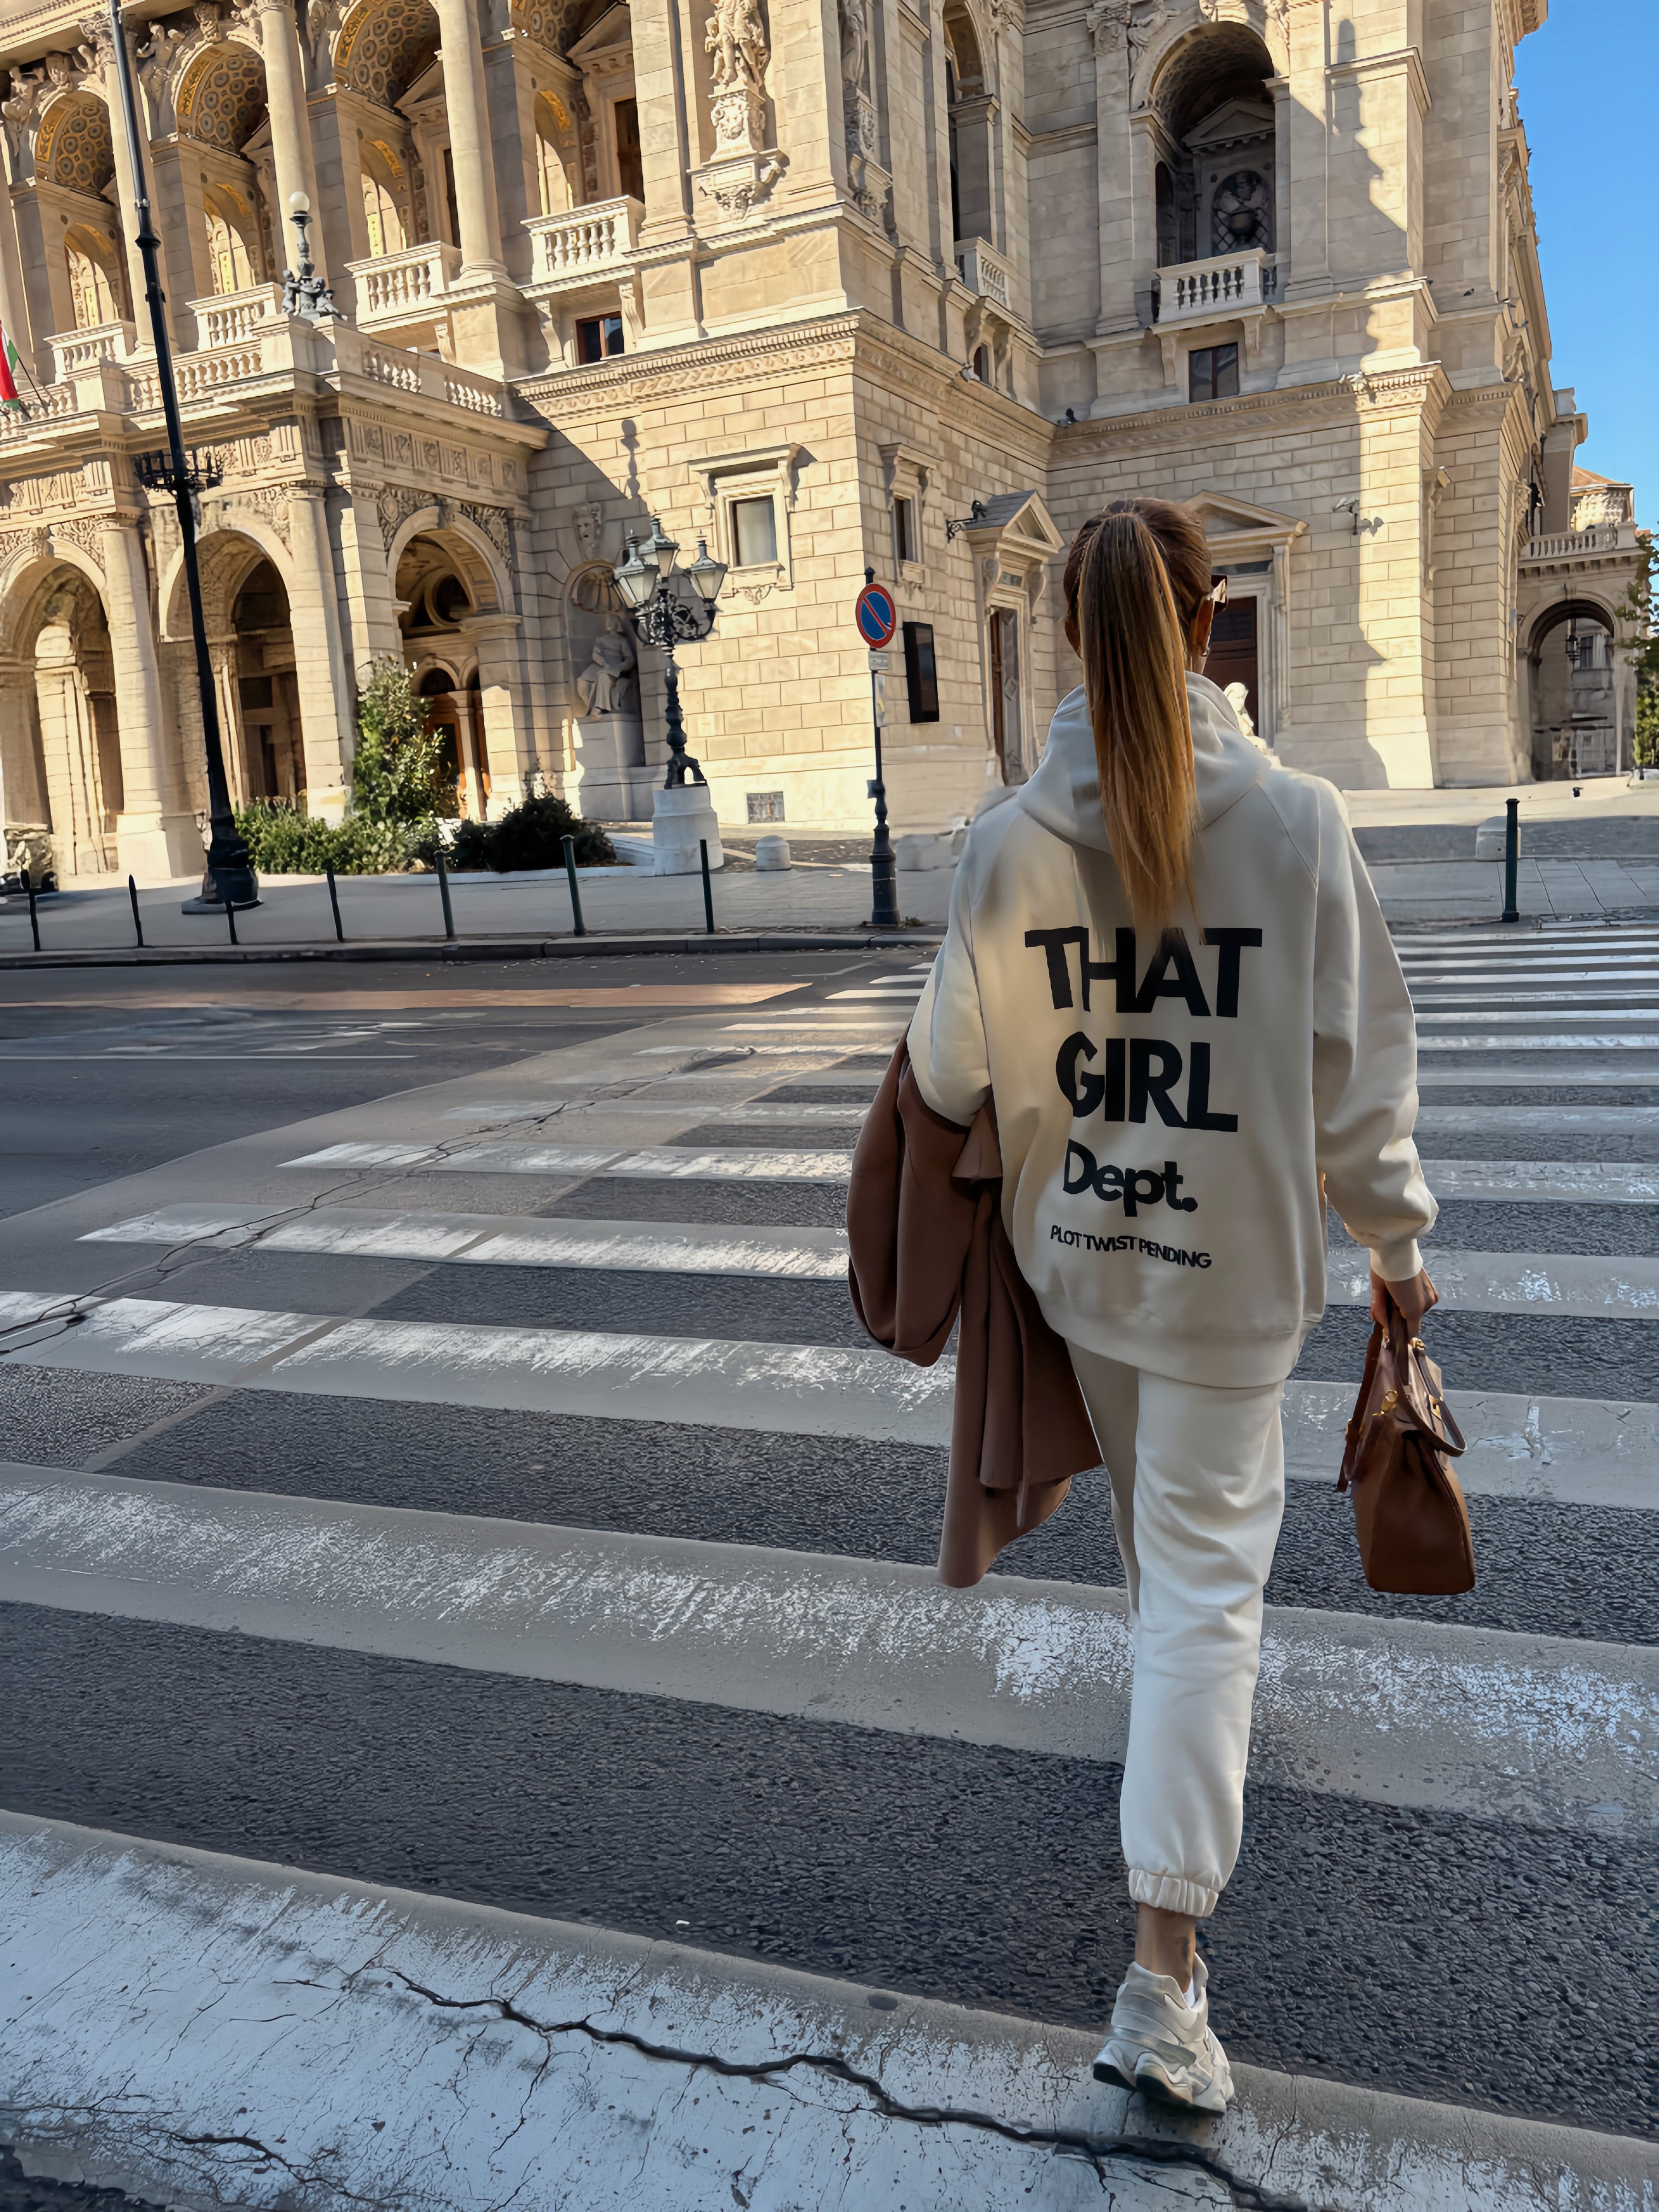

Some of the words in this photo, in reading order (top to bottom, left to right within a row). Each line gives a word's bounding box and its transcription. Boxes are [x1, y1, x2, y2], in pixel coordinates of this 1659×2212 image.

[1025, 926, 1262, 1018] THAT
[1056, 1031, 1238, 1132] GIRL
[1063, 1138, 1198, 1217] Dept.
[1051, 1225, 1082, 1248] PLOT
[1083, 1234, 1138, 1251] TWIST
[1139, 1238, 1212, 1269] PENDING
